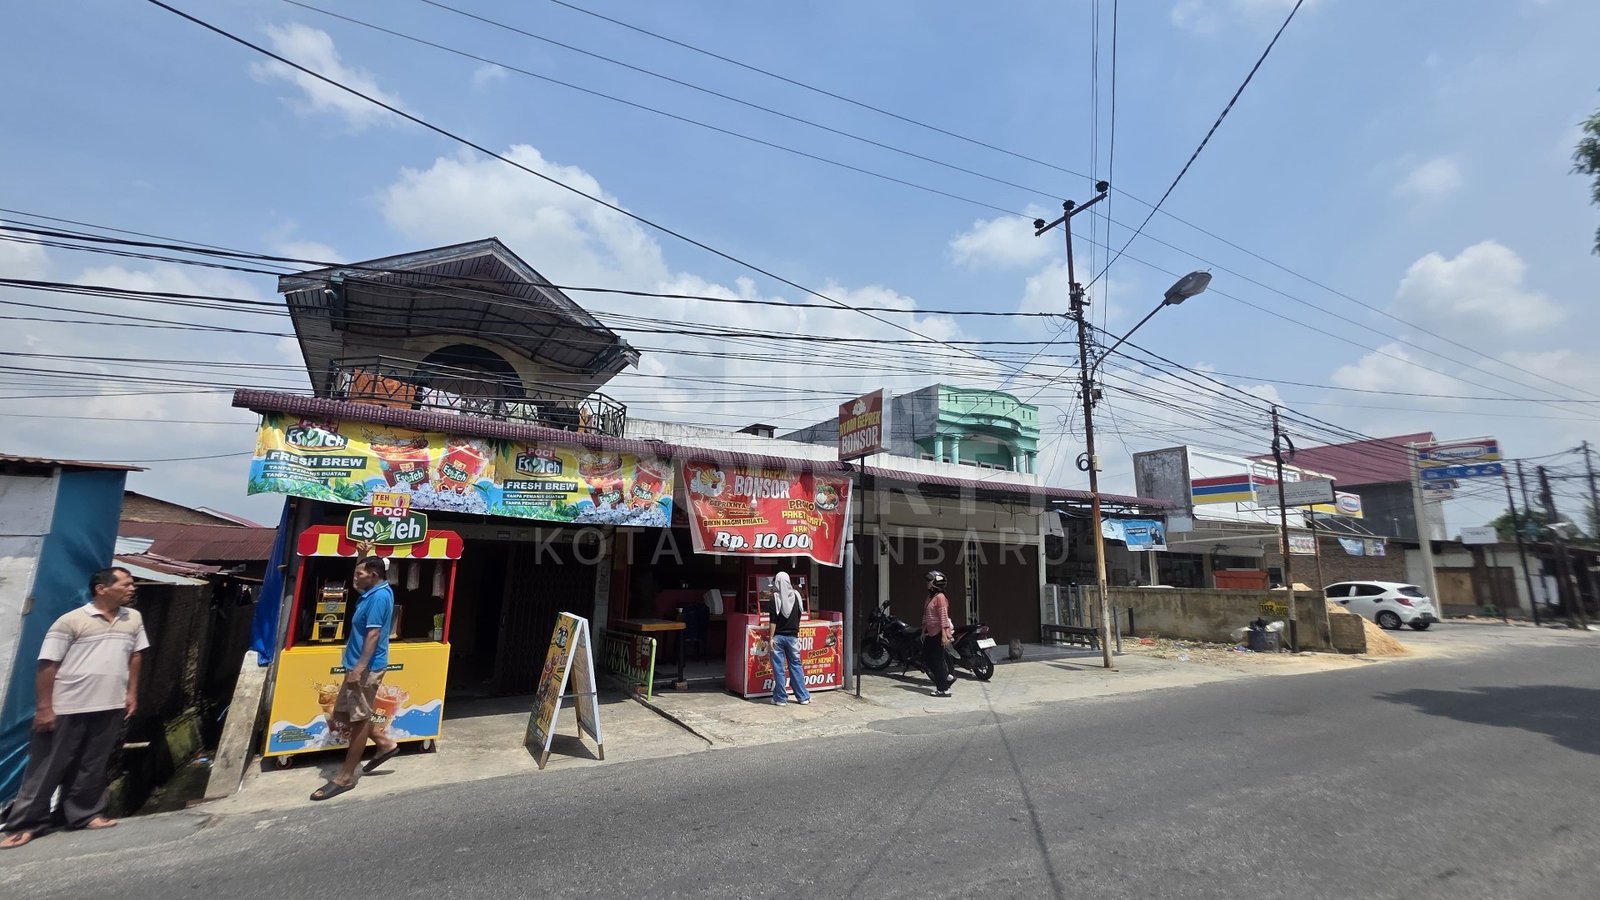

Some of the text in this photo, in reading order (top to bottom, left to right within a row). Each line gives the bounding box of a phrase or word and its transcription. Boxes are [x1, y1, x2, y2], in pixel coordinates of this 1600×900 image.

[857, 410, 881, 429] GEPREK
[841, 425, 879, 454] BONSOR
[527, 446, 554, 458] POCI
[321, 458, 363, 467] BREW
[545, 482, 576, 491] BREW
[734, 475, 791, 500] BONSOR
[373, 506, 407, 517] POCI
[351, 516, 421, 540] Es Teh
[713, 531, 749, 552] Rp.
[797, 628, 816, 637] EPREK
[808, 648, 828, 658] PROMO
